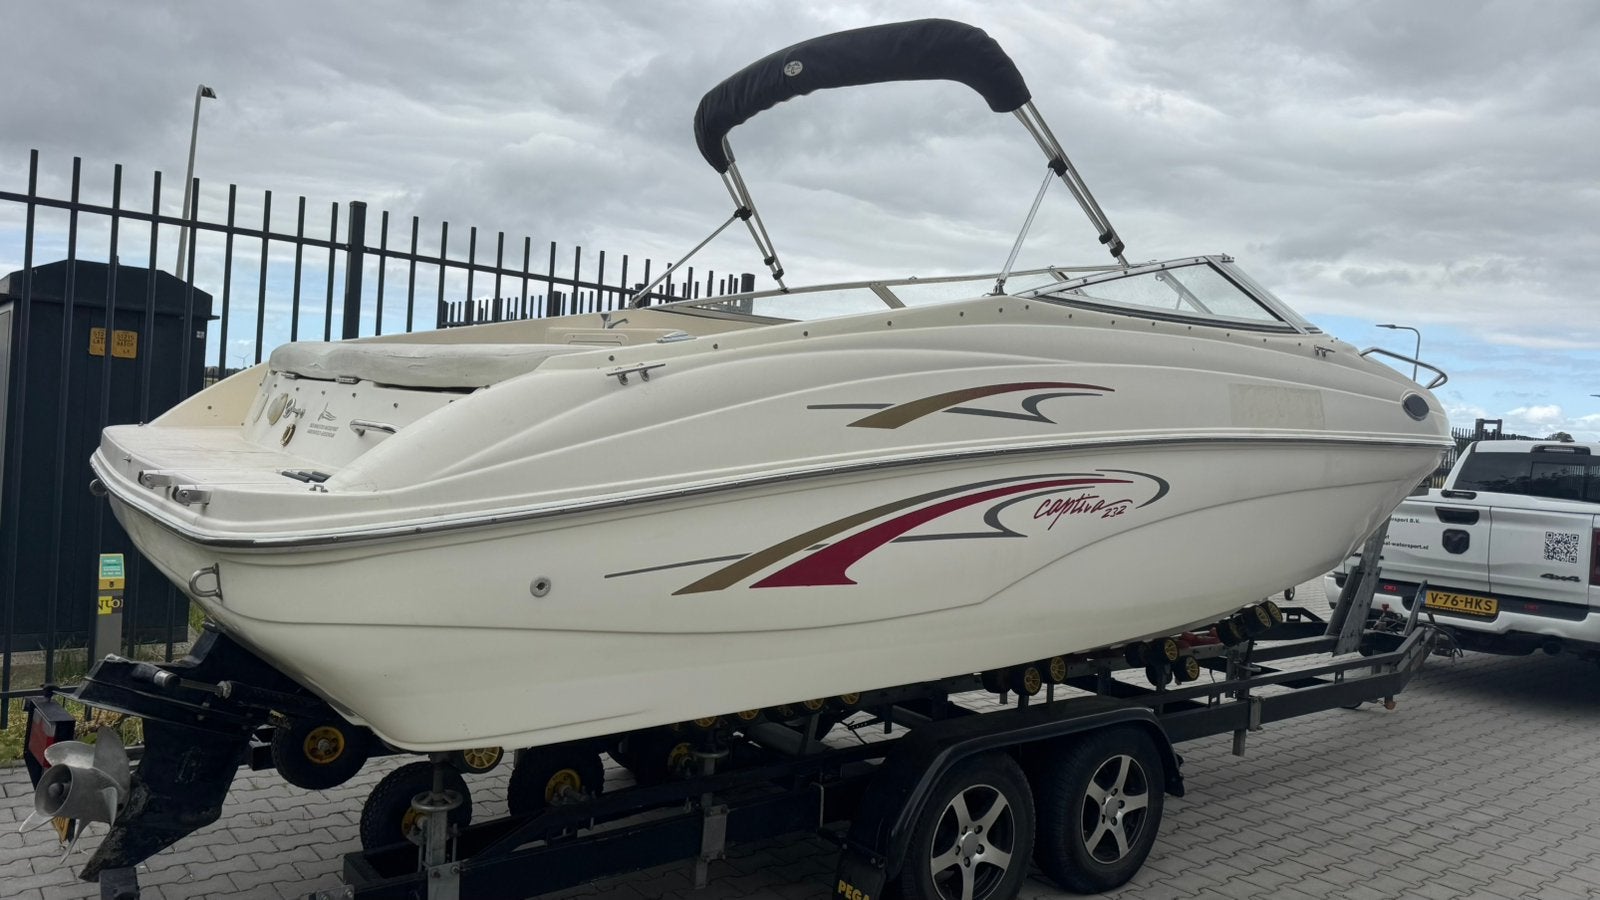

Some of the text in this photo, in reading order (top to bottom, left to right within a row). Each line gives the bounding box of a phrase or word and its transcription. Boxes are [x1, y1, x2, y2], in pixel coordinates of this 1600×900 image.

[1101, 506, 1127, 519] 232
[1540, 573, 1581, 582] 4x4
[1430, 592, 1493, 611] V-76-HKS
